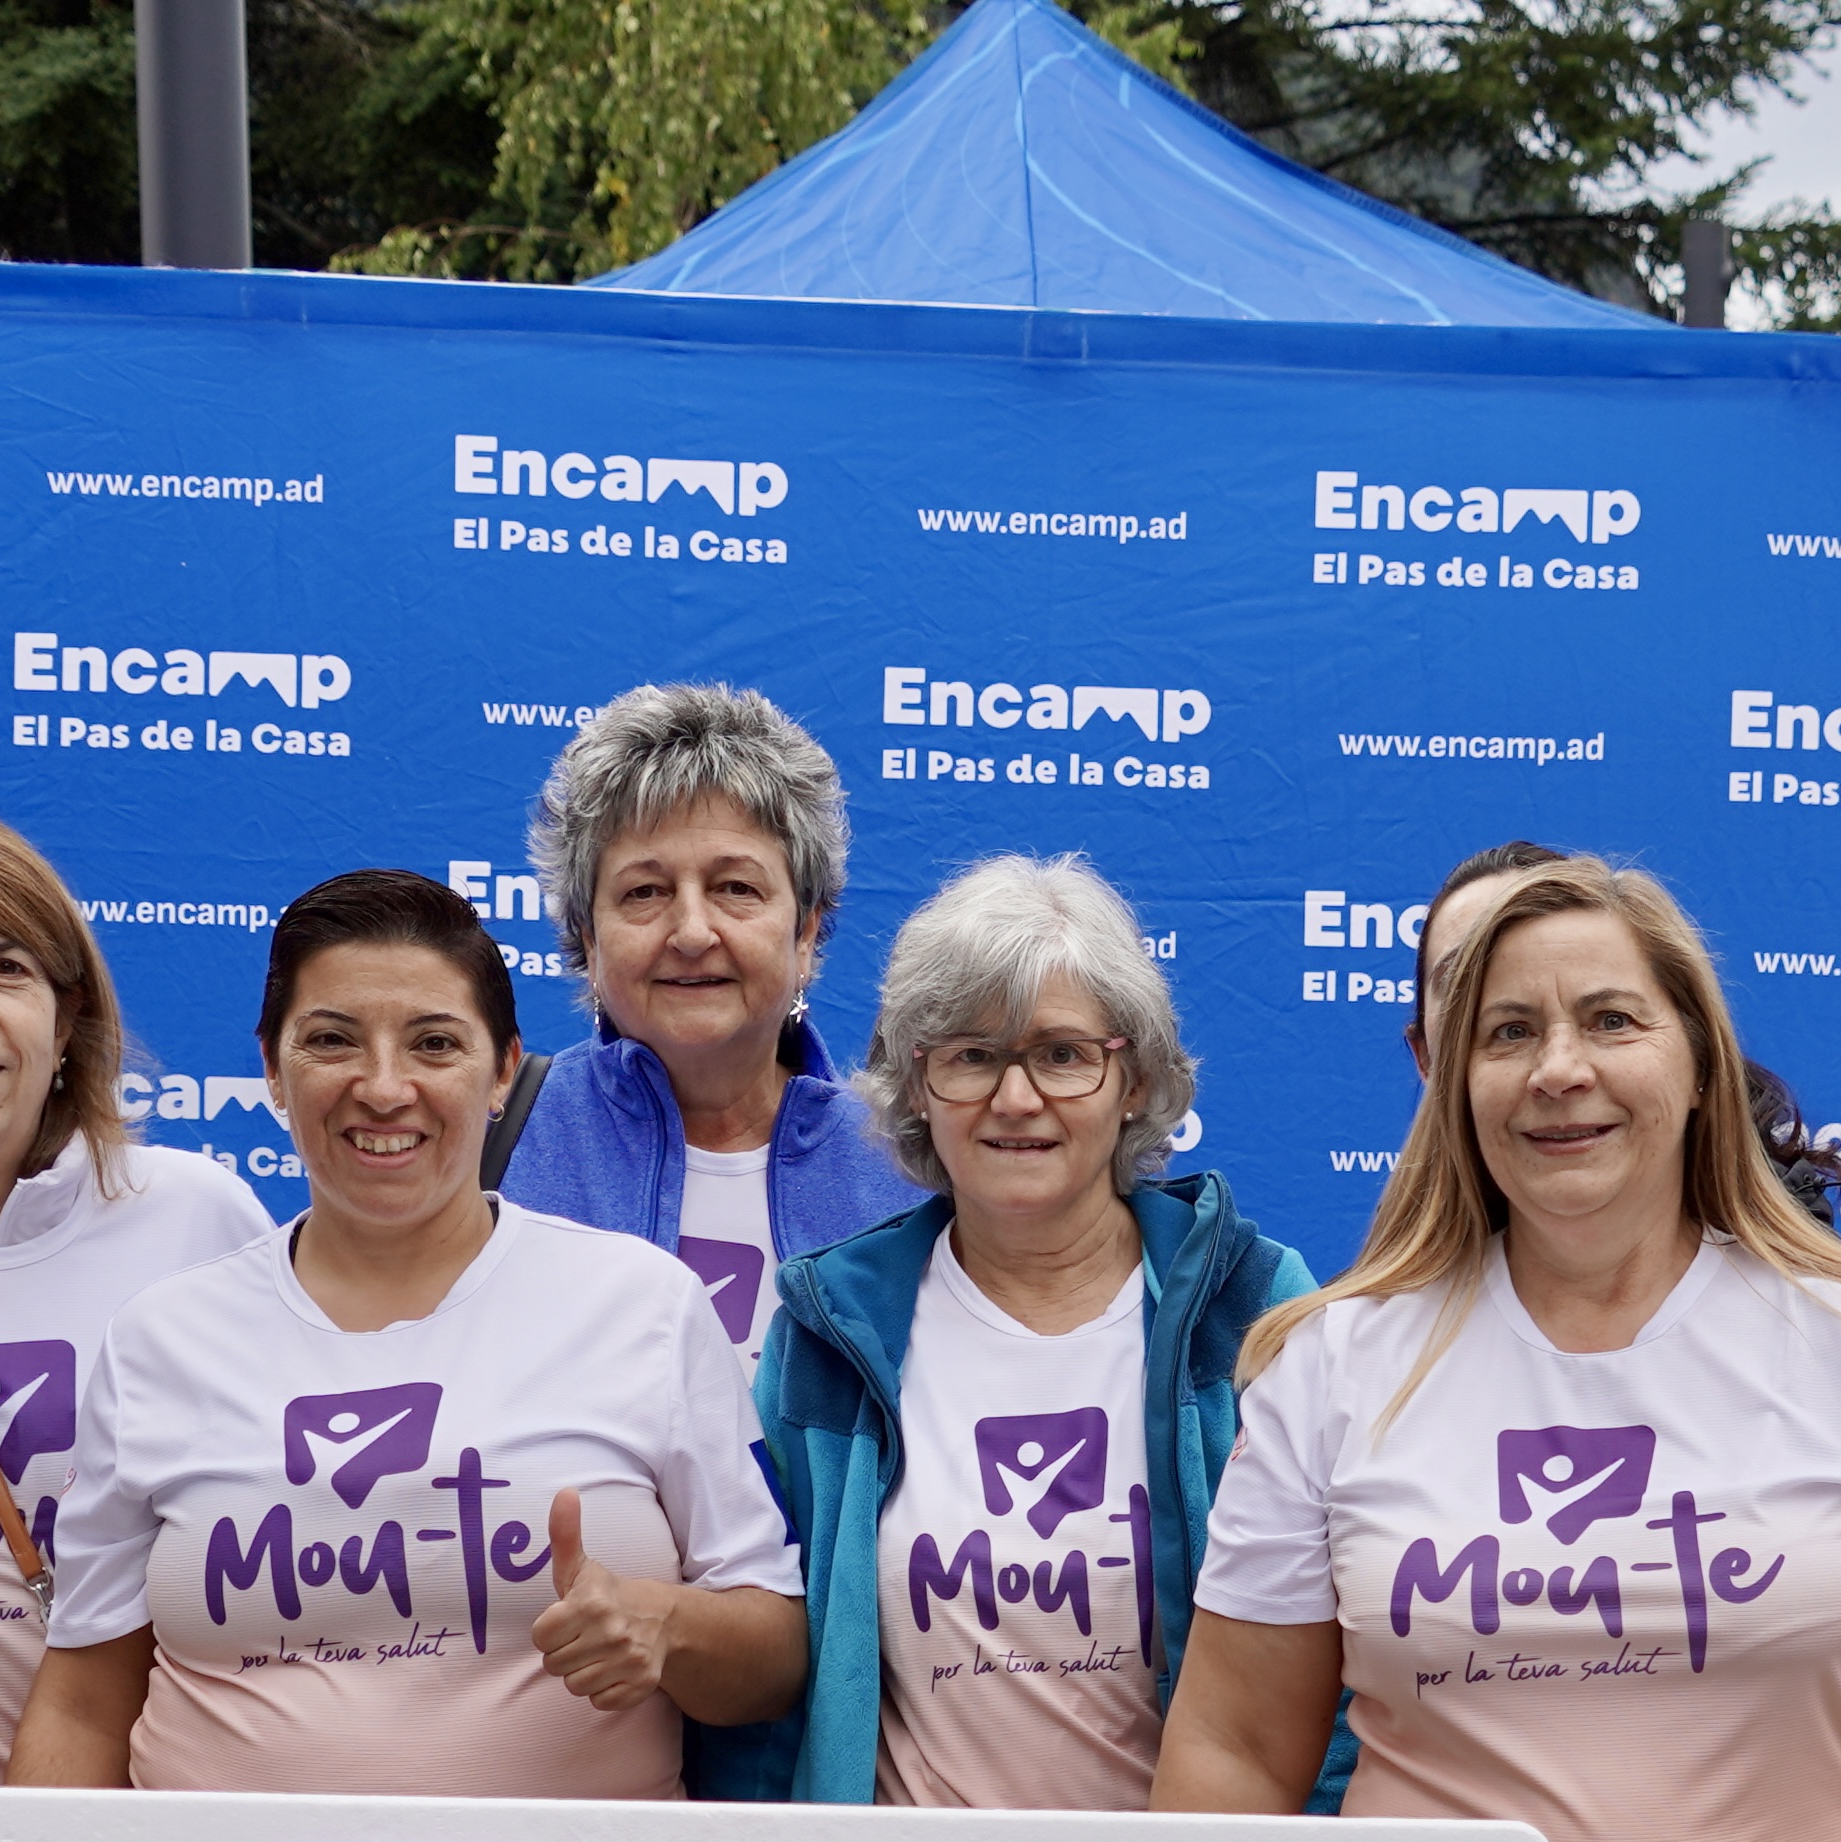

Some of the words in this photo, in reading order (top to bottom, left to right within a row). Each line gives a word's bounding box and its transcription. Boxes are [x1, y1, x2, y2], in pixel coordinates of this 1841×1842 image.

[46, 471, 324, 507] www.encamp.ad
[454, 434, 789, 517] Encamp
[917, 508, 1187, 545] www.encamp.ad
[1314, 470, 1641, 544] Encamp
[453, 517, 489, 550] El
[500, 520, 570, 554] Pas
[580, 524, 633, 557] de
[644, 525, 680, 559] la
[689, 530, 788, 564] Casa
[1313, 551, 1348, 584] El
[1358, 554, 1426, 587] Pas
[1436, 556, 1488, 587] de
[1498, 555, 1534, 588] la
[1542, 558, 1639, 590] Casa
[13, 632, 352, 709] Encamp
[883, 666, 1212, 743] Encamp
[13, 714, 49, 747] El
[60, 717, 130, 749] Pas
[140, 719, 194, 751] de
[206, 719, 242, 752] la
[251, 723, 351, 757] Casa
[1338, 732, 1605, 767] www.encamp.ad
[882, 747, 917, 780] El
[927, 750, 995, 783] Pas
[1006, 753, 1058, 784] de
[1069, 753, 1104, 786] la
[1113, 756, 1210, 790] Casa
[1728, 770, 1763, 802] El
[1773, 773, 1840, 806] Pas
[1303, 970, 1337, 1002] El
[1348, 972, 1415, 1004] Pas
[204, 1447, 552, 1656] Mou-te
[908, 1482, 1155, 1668] Mou-t
[1389, 1490, 1786, 1675] Mou-te
[279, 1634, 308, 1664] la
[306, 1634, 368, 1665] teva
[376, 1620, 468, 1658] salut
[932, 1663, 962, 1694] per
[974, 1645, 999, 1676] la
[998, 1651, 1053, 1675] teva
[1059, 1640, 1137, 1679] salut
[1415, 1666, 1451, 1701] per
[1464, 1650, 1496, 1683] la
[1495, 1653, 1569, 1679] teva
[1580, 1641, 1682, 1683] salut
